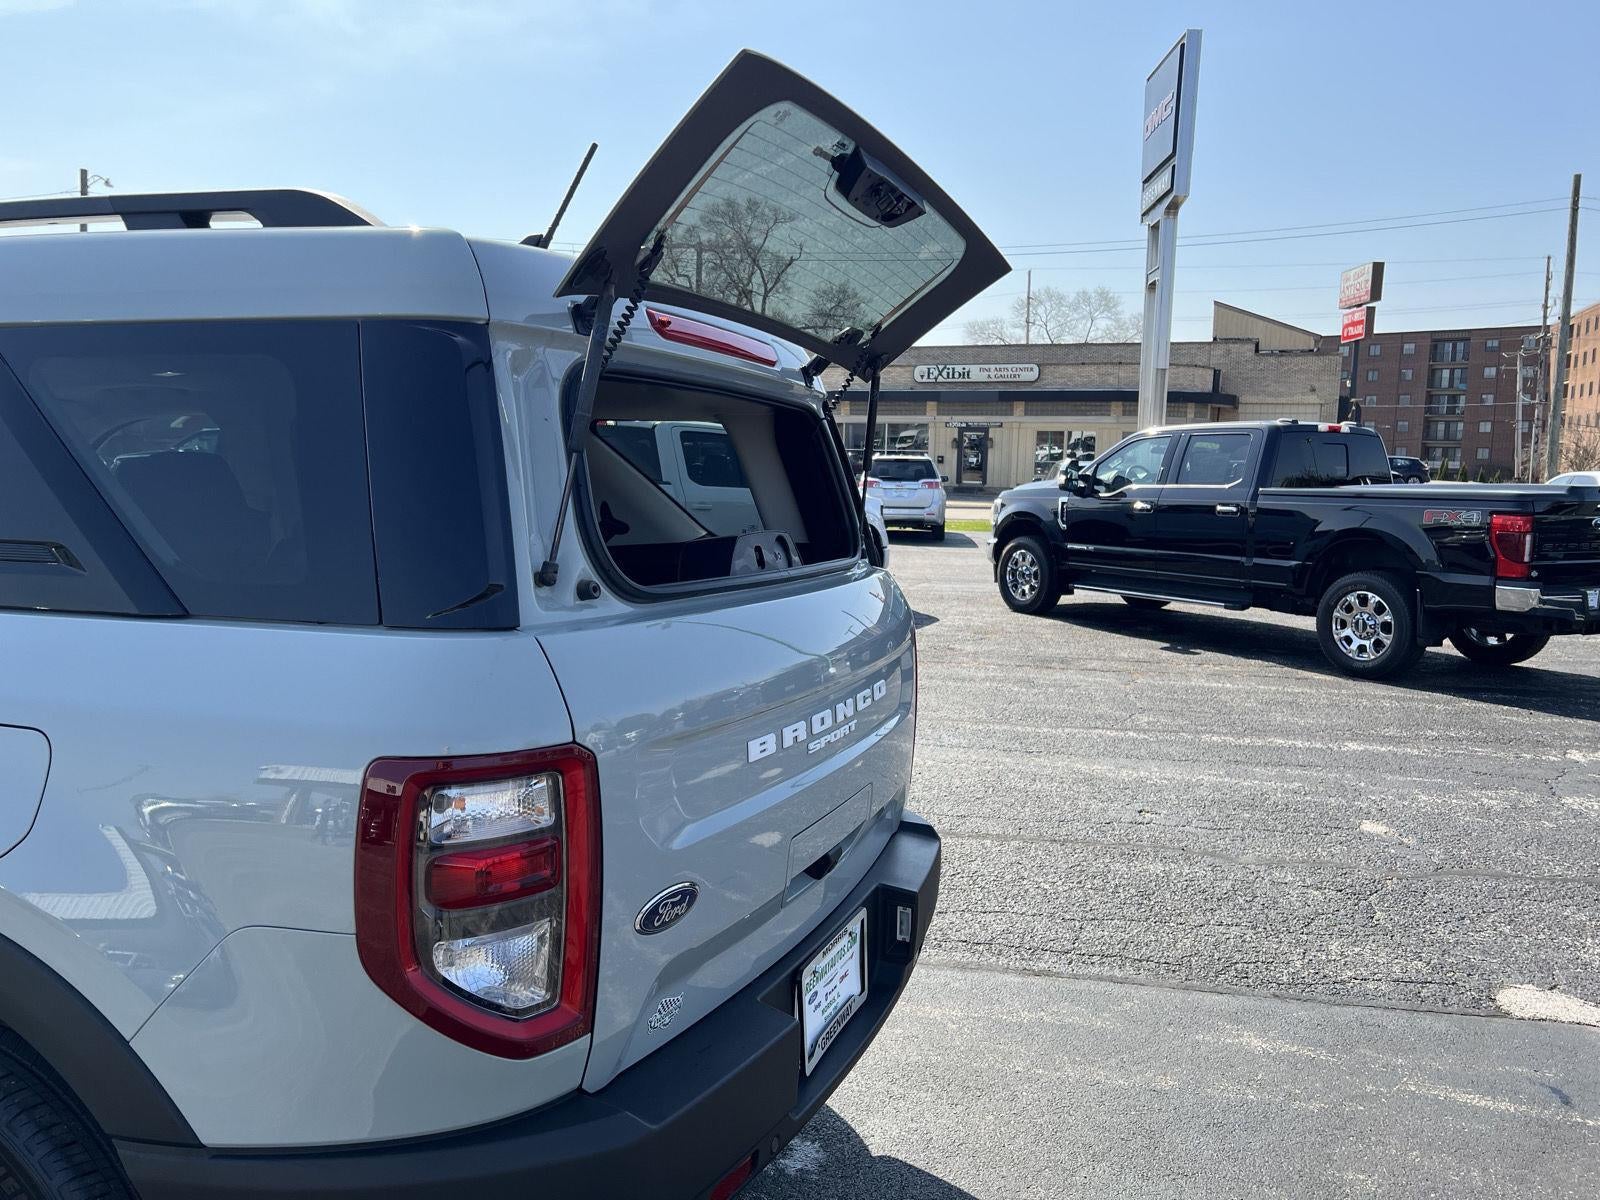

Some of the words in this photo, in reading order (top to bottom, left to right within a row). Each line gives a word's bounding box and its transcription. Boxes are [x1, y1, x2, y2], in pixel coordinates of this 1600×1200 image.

[1145, 91, 1175, 142] GMC
[1423, 509, 1482, 524] FX4
[747, 679, 887, 763] BRONCO
[807, 719, 858, 754] SPORT
[654, 894, 690, 927] Ford
[821, 926, 849, 959] MORRIS
[820, 1001, 854, 1051] GREENWAY
